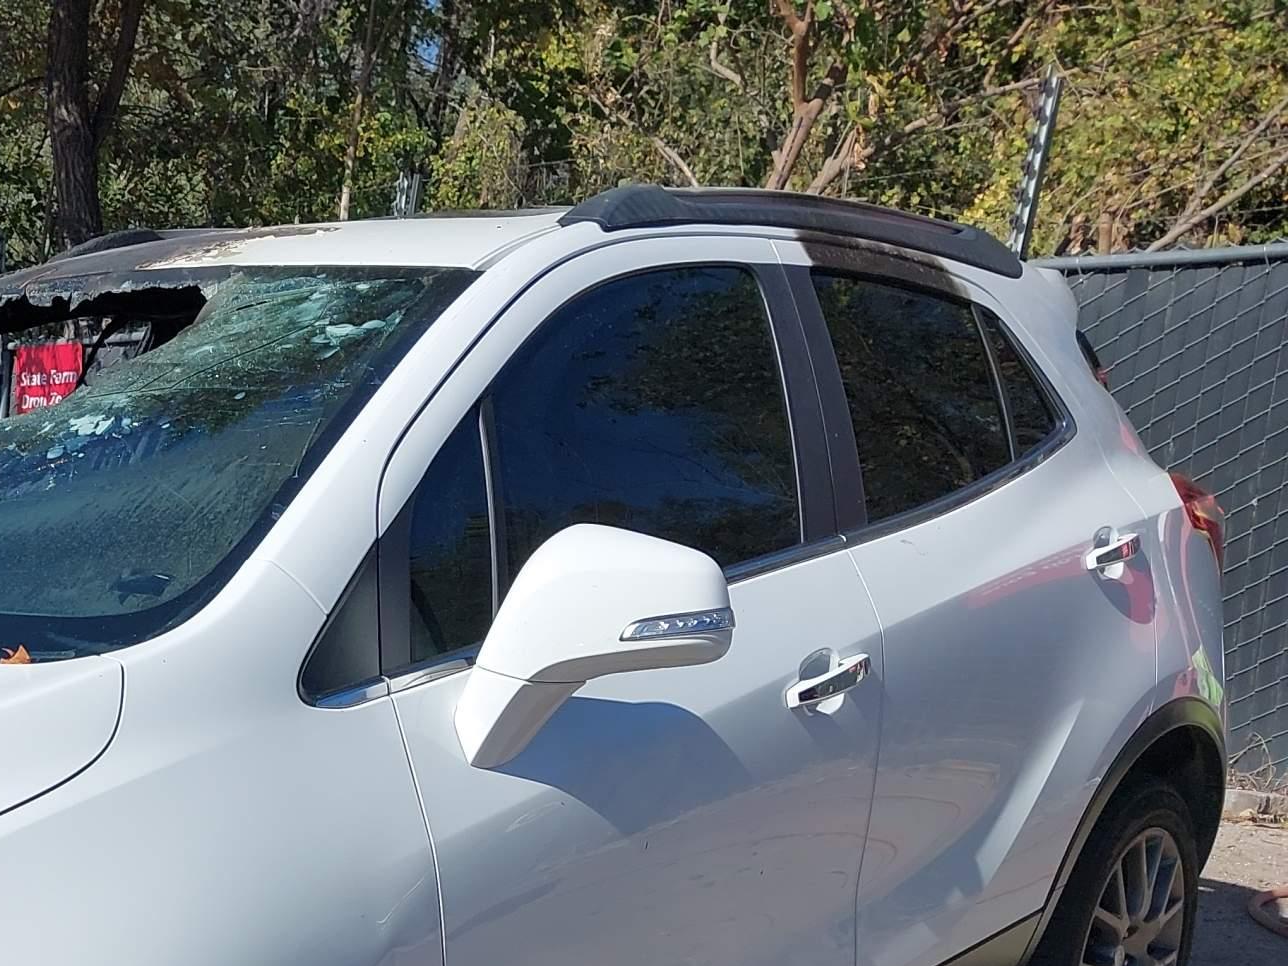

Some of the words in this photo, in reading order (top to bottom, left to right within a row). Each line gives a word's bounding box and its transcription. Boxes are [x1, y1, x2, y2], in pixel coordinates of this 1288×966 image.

[20, 372, 47, 386] State
[50, 369, 77, 385] Farm
[49, 391, 63, 406] Zo
